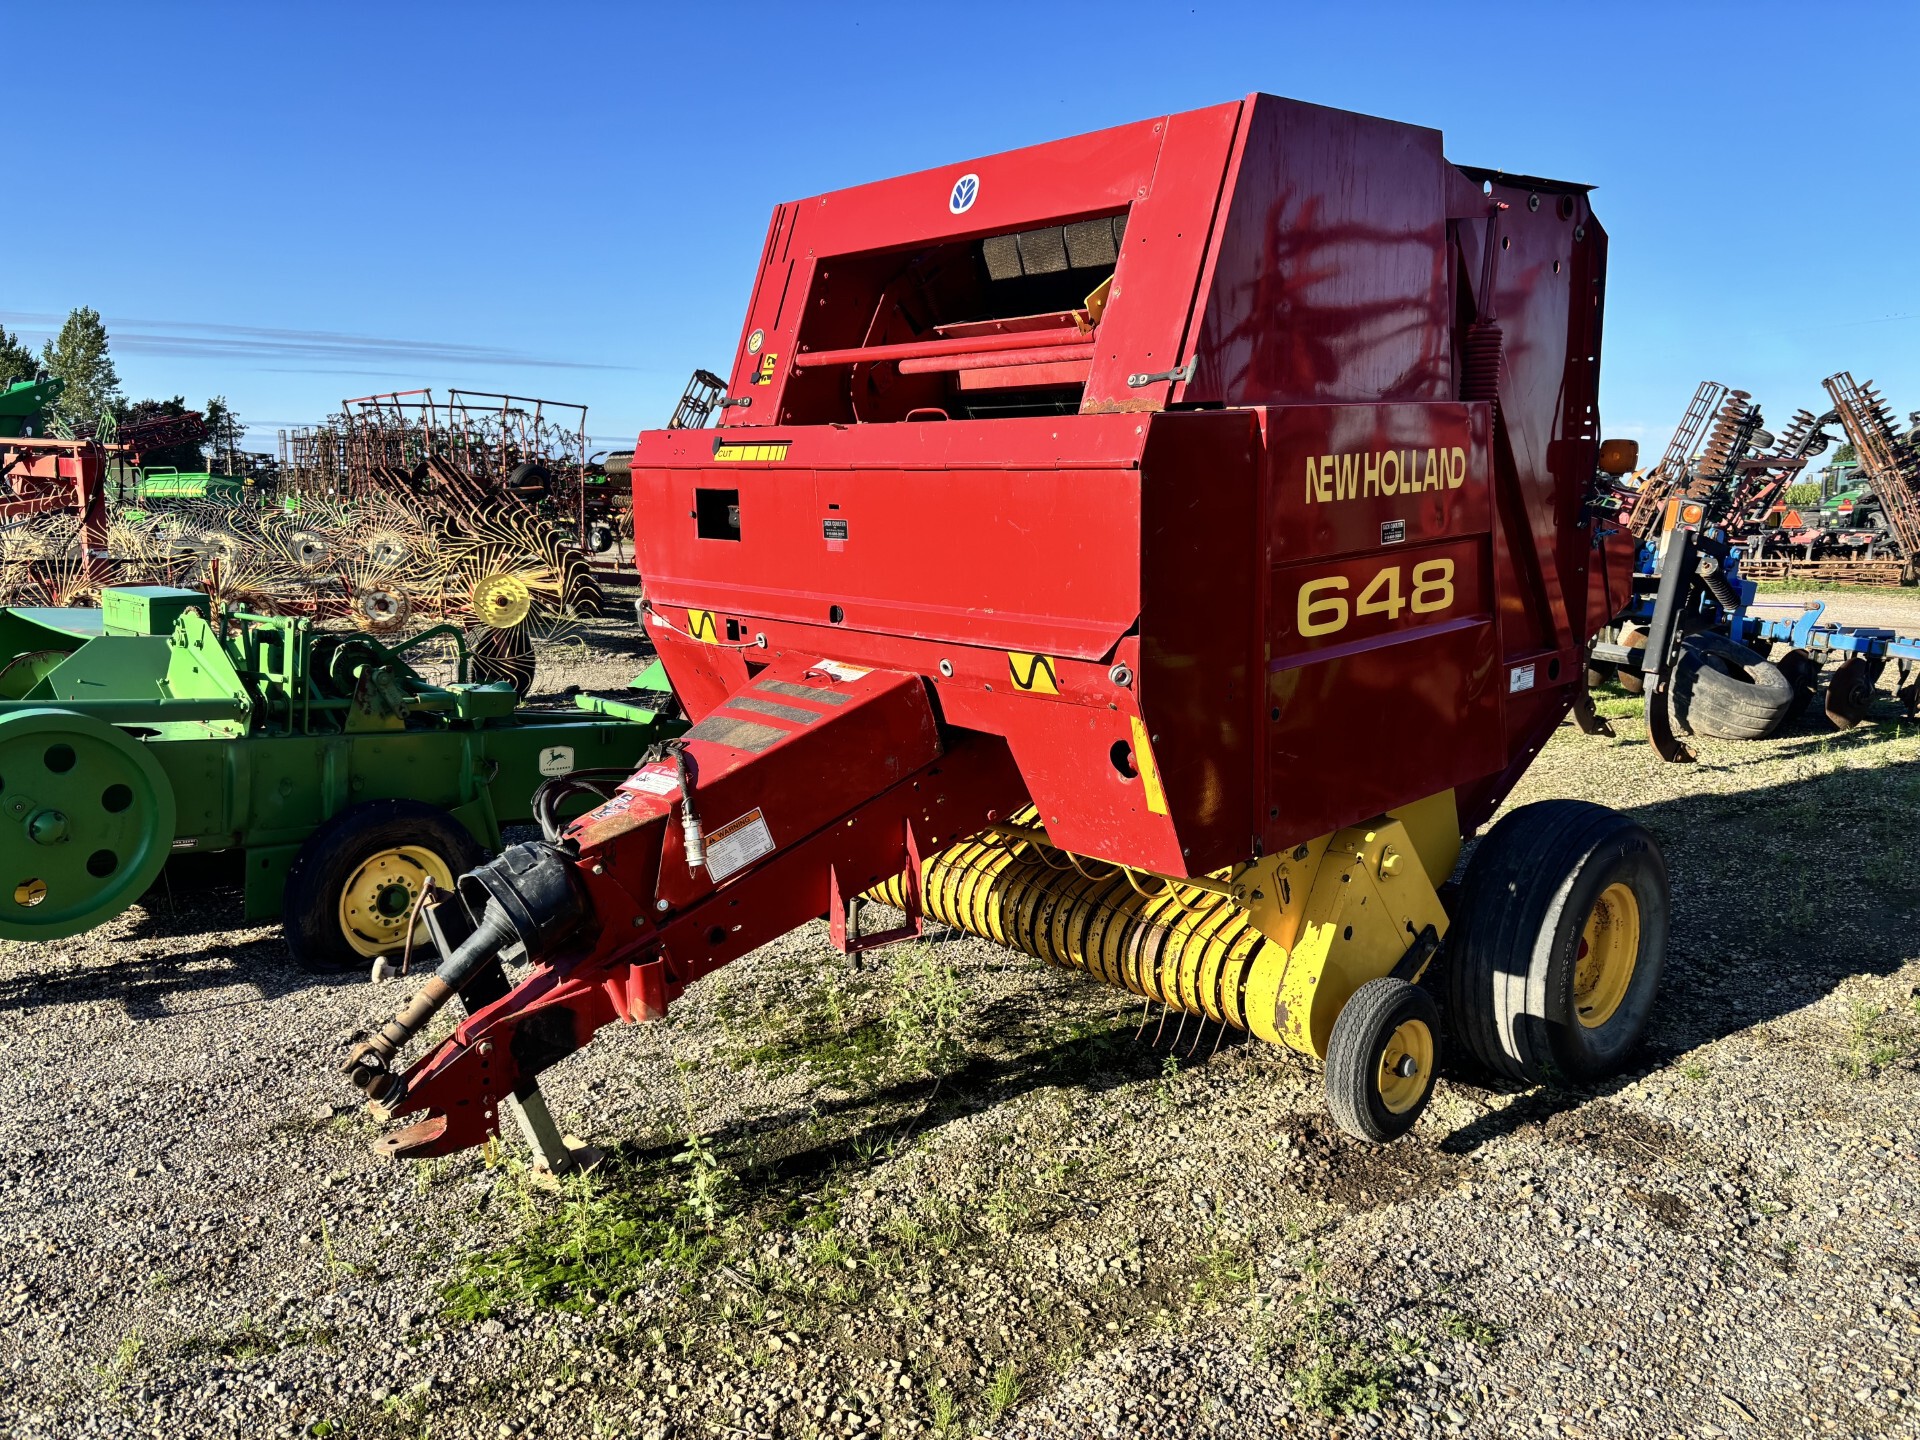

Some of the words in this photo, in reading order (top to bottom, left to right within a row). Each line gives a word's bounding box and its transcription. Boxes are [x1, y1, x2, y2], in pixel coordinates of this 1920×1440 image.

[1306, 453, 1360, 504] NEW
[1363, 447, 1466, 497] HOLLAND
[1297, 559, 1455, 637] 648
[717, 816, 750, 838] WARNING
